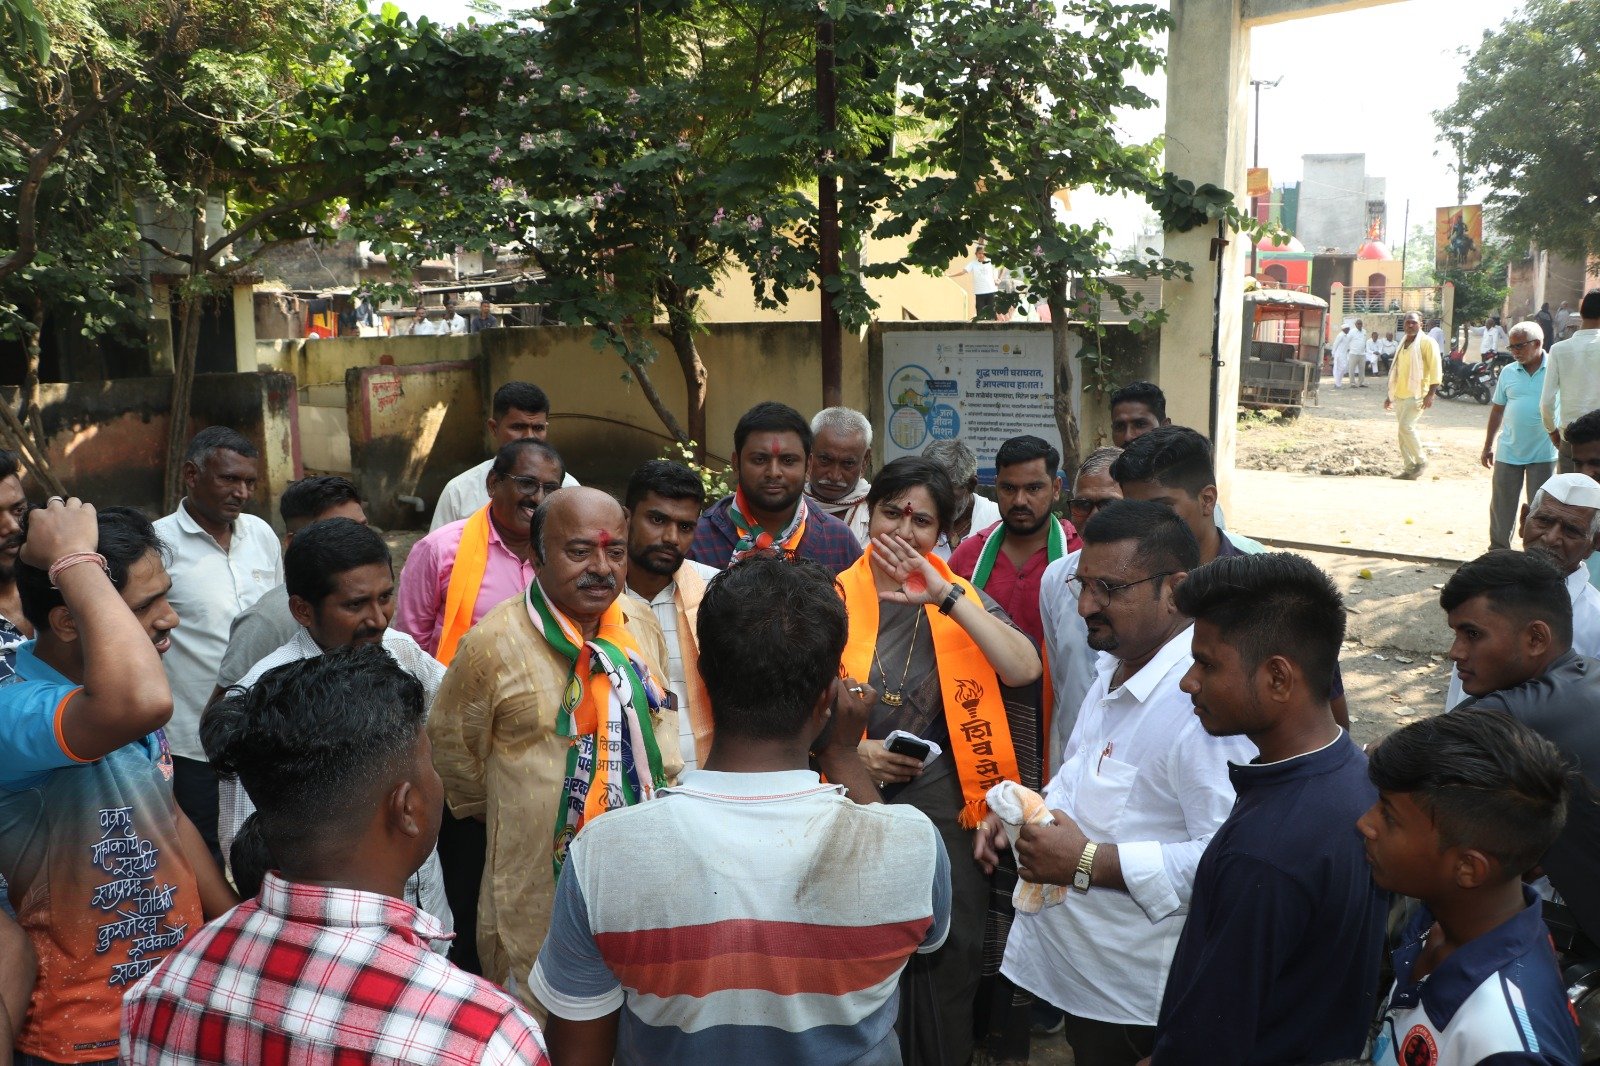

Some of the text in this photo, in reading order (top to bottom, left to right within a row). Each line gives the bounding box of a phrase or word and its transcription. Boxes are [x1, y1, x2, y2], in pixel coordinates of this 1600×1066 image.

[976, 366, 1044, 378] शुद्ध पाणी घराघरात,
[982, 381, 1016, 389] आपल्याच
[939, 409, 953, 417] जल
[933, 416, 953, 426] जीवन
[932, 426, 953, 435] मिशन
